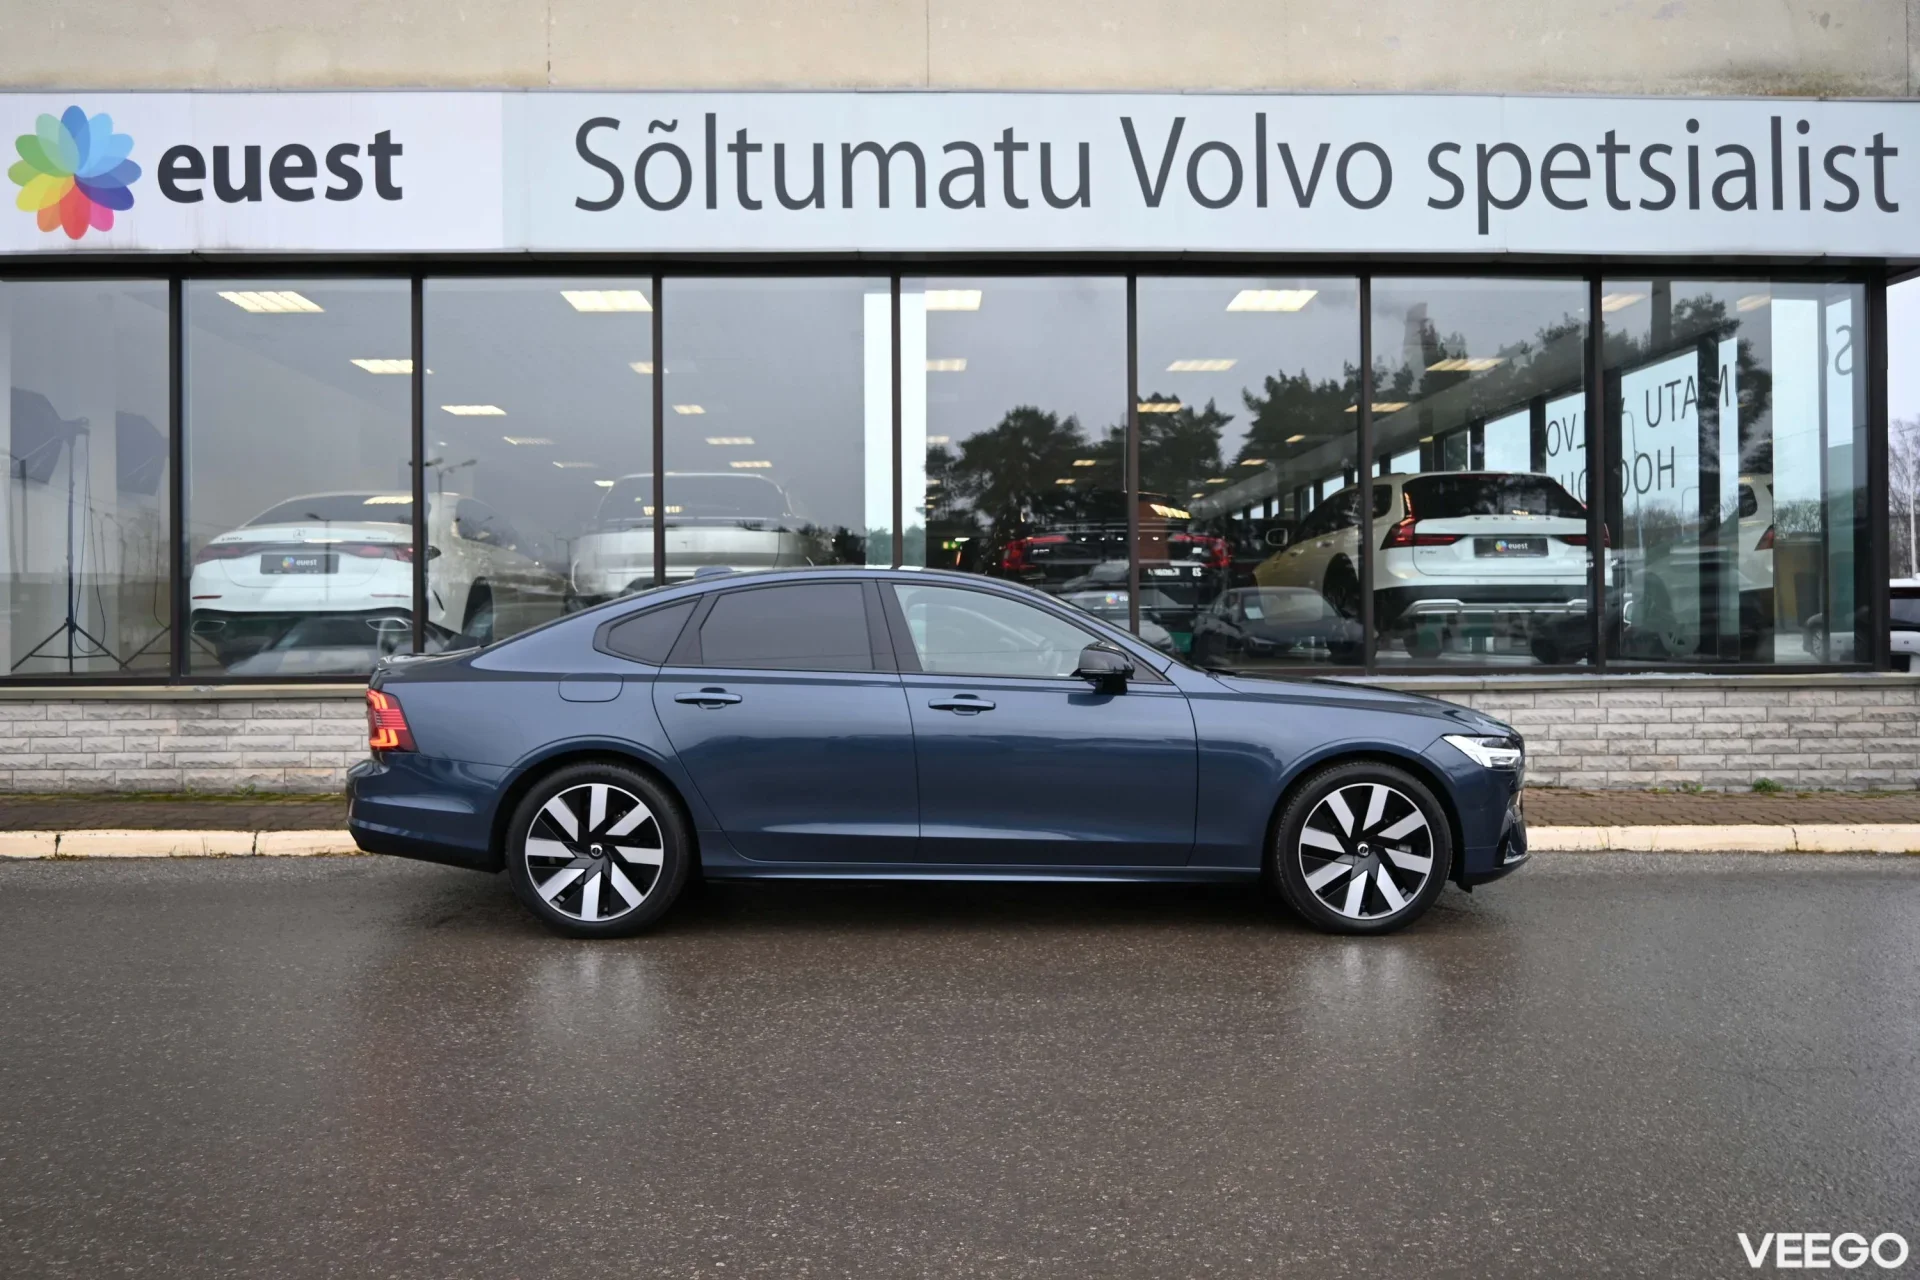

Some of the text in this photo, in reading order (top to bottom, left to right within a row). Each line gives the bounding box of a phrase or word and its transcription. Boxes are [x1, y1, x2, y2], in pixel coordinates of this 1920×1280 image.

[157, 129, 403, 204] euest
[575, 112, 1900, 235] Sõltumatu Volvo spetsialist
[1507, 542, 1529, 550] euest
